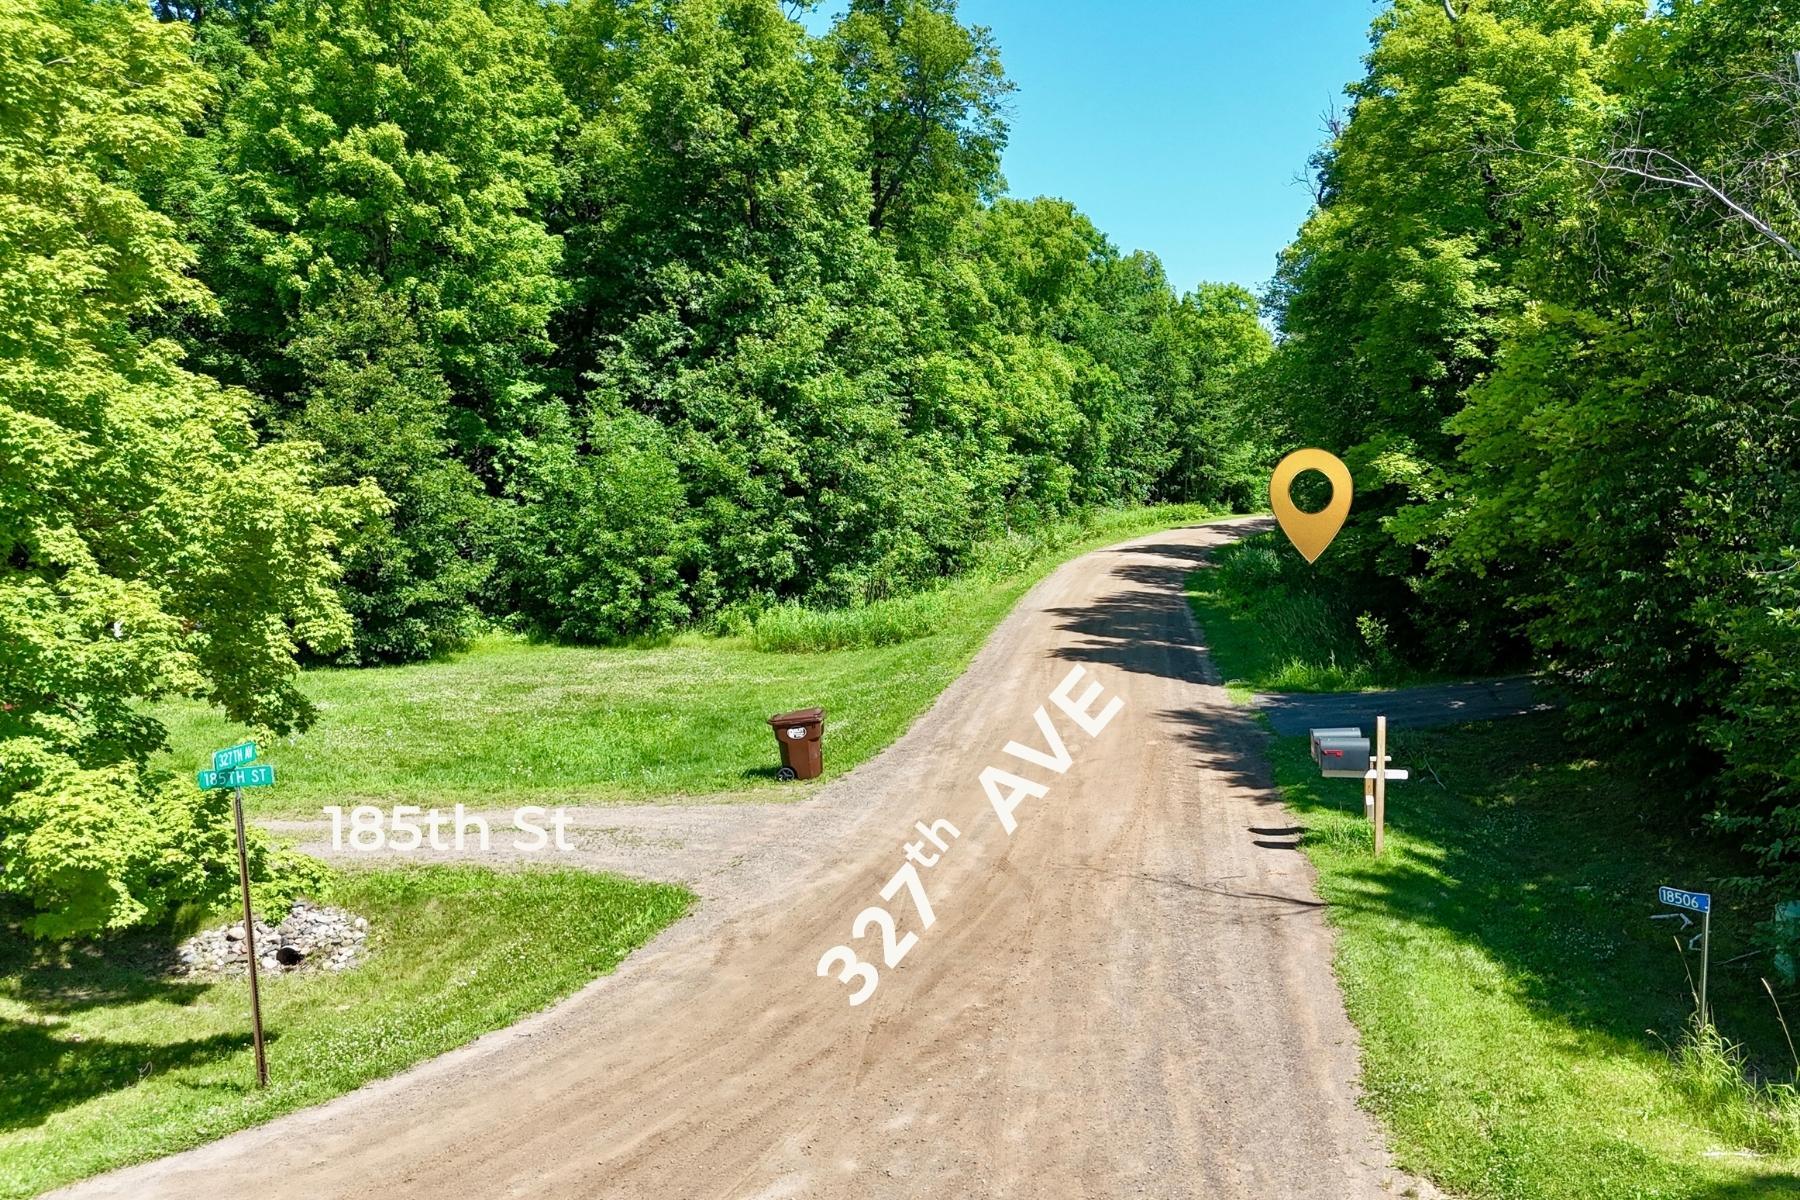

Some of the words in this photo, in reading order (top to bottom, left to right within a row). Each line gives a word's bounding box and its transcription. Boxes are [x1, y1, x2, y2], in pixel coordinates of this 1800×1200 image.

[218, 749, 243, 768] 327TH
[203, 770, 246, 787] 185TH
[251, 768, 267, 783] ST
[1661, 889, 1699, 909] 18506
